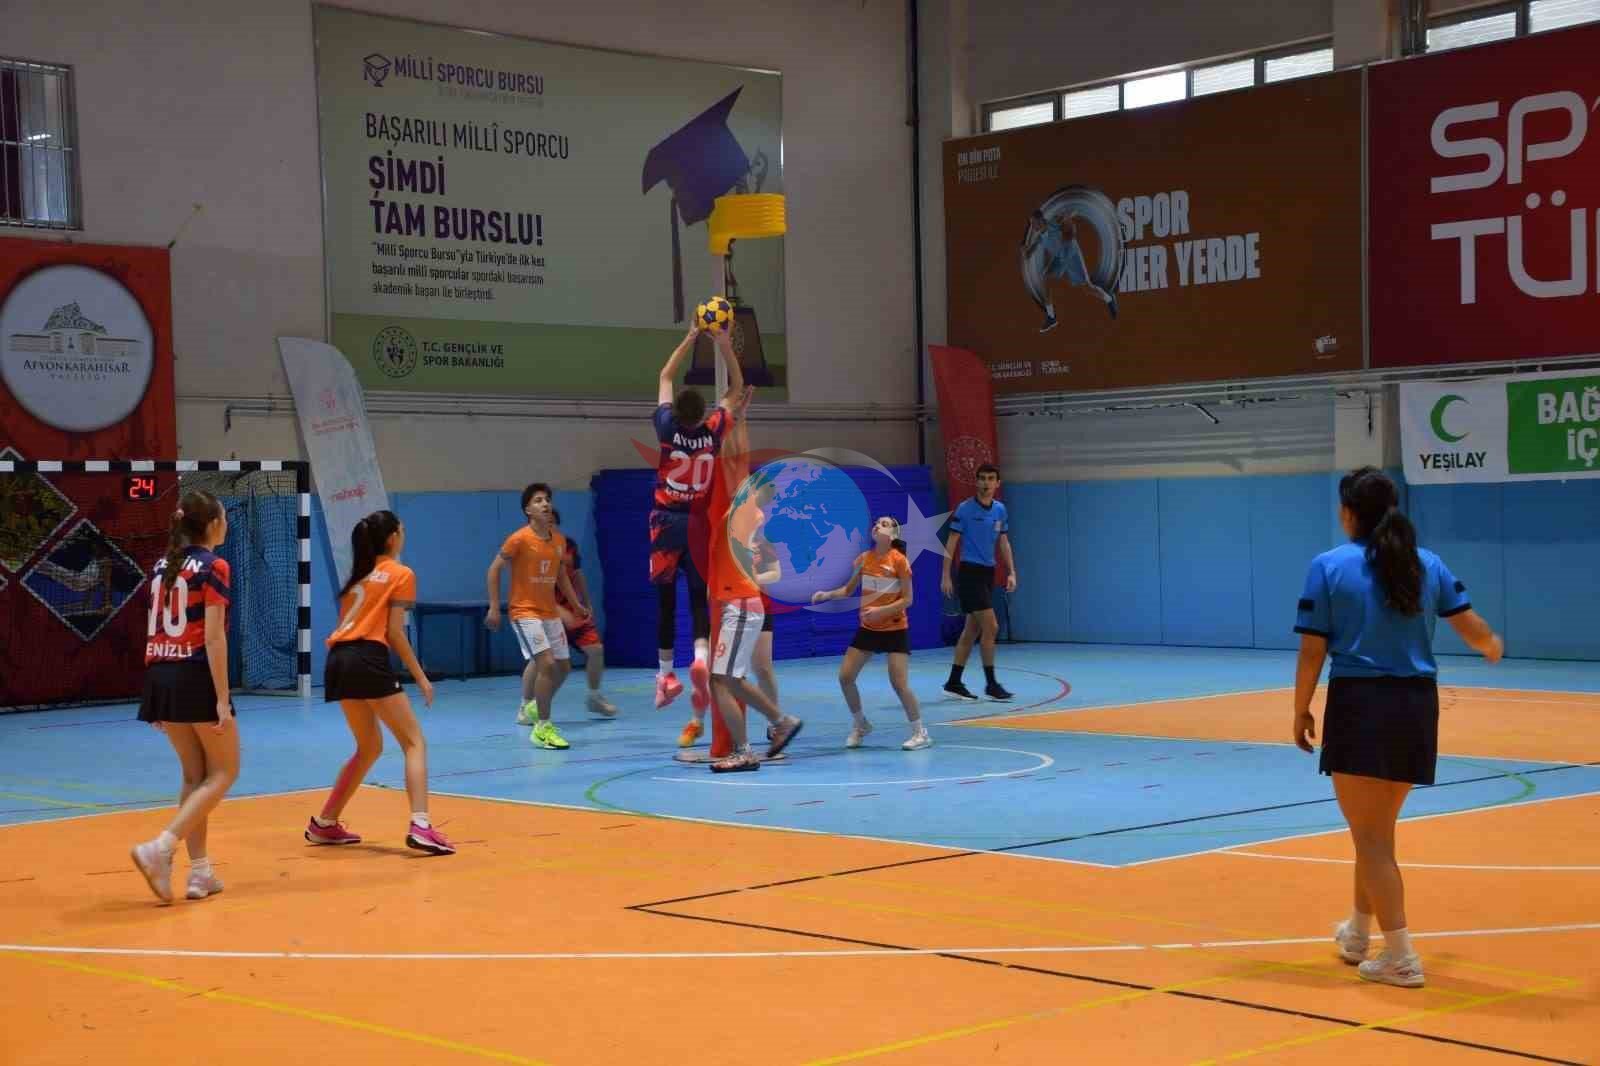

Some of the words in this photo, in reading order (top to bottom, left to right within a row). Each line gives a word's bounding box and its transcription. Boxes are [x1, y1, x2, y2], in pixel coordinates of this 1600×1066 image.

[437, 63, 494, 89] SPORCU
[498, 71, 544, 95] BURSU
[366, 112, 447, 147] BAŞARILI
[503, 129, 569, 160] SPORCU
[1430, 91, 1600, 195] SP
[368, 150, 445, 198] ŞİMDİ
[369, 200, 425, 237] TAM
[434, 206, 543, 246] BURSLU!
[1117, 190, 1190, 242] SPOR
[399, 245, 429, 261] Sporcu
[1174, 231, 1261, 287] YERDE
[1430, 189, 1600, 305] TÜ
[373, 282, 413, 297] akademik
[430, 267, 469, 282] sporcular
[422, 341, 441, 352] T.C.
[443, 341, 487, 355] GENÇLİK
[490, 343, 504, 354] VE
[423, 355, 449, 367] SPOR
[451, 355, 504, 369] BAKANLIĞI
[666, 450, 714, 491] 20
[1419, 451, 1486, 473] YEŞİLAY
[129, 478, 154, 497] 24
[147, 574, 188, 638] 10
